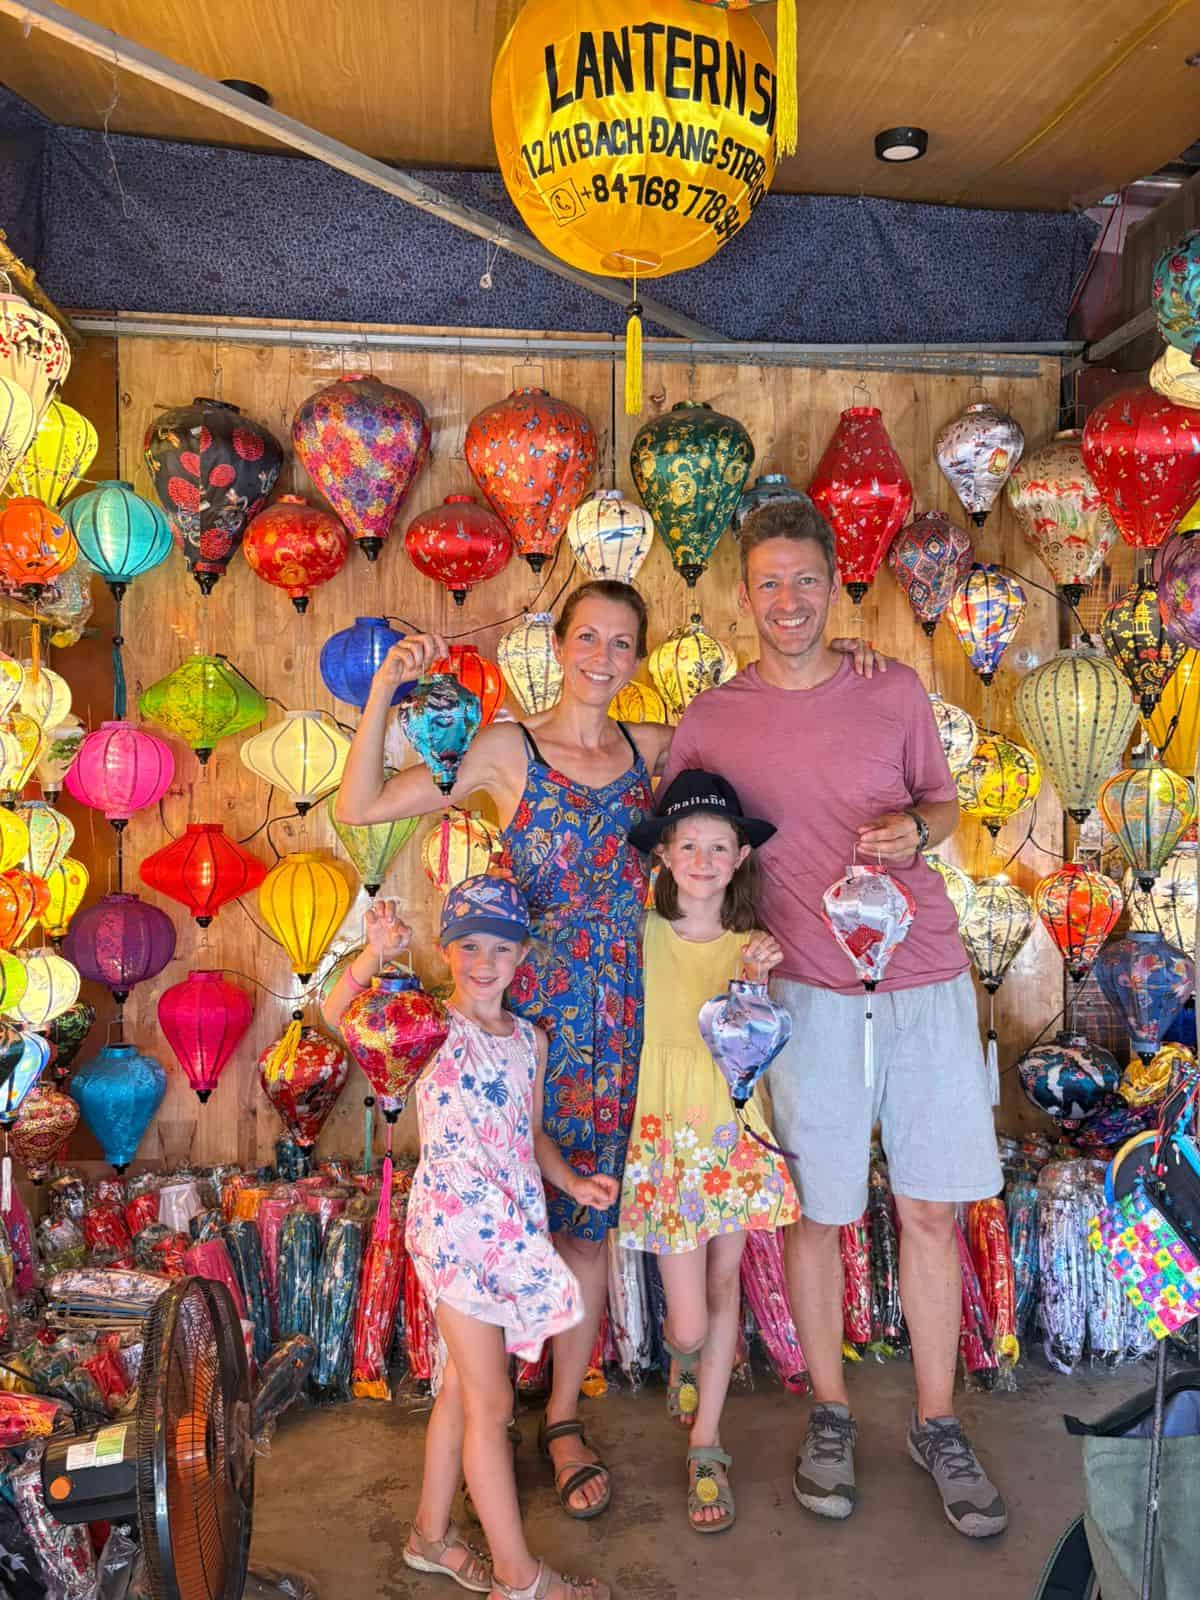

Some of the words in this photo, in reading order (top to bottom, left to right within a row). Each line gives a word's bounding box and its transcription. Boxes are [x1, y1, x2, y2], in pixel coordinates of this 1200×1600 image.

[544, 21, 746, 116] LANTERN
[521, 127, 577, 179] 12/11
[573, 117, 643, 158] BACH
